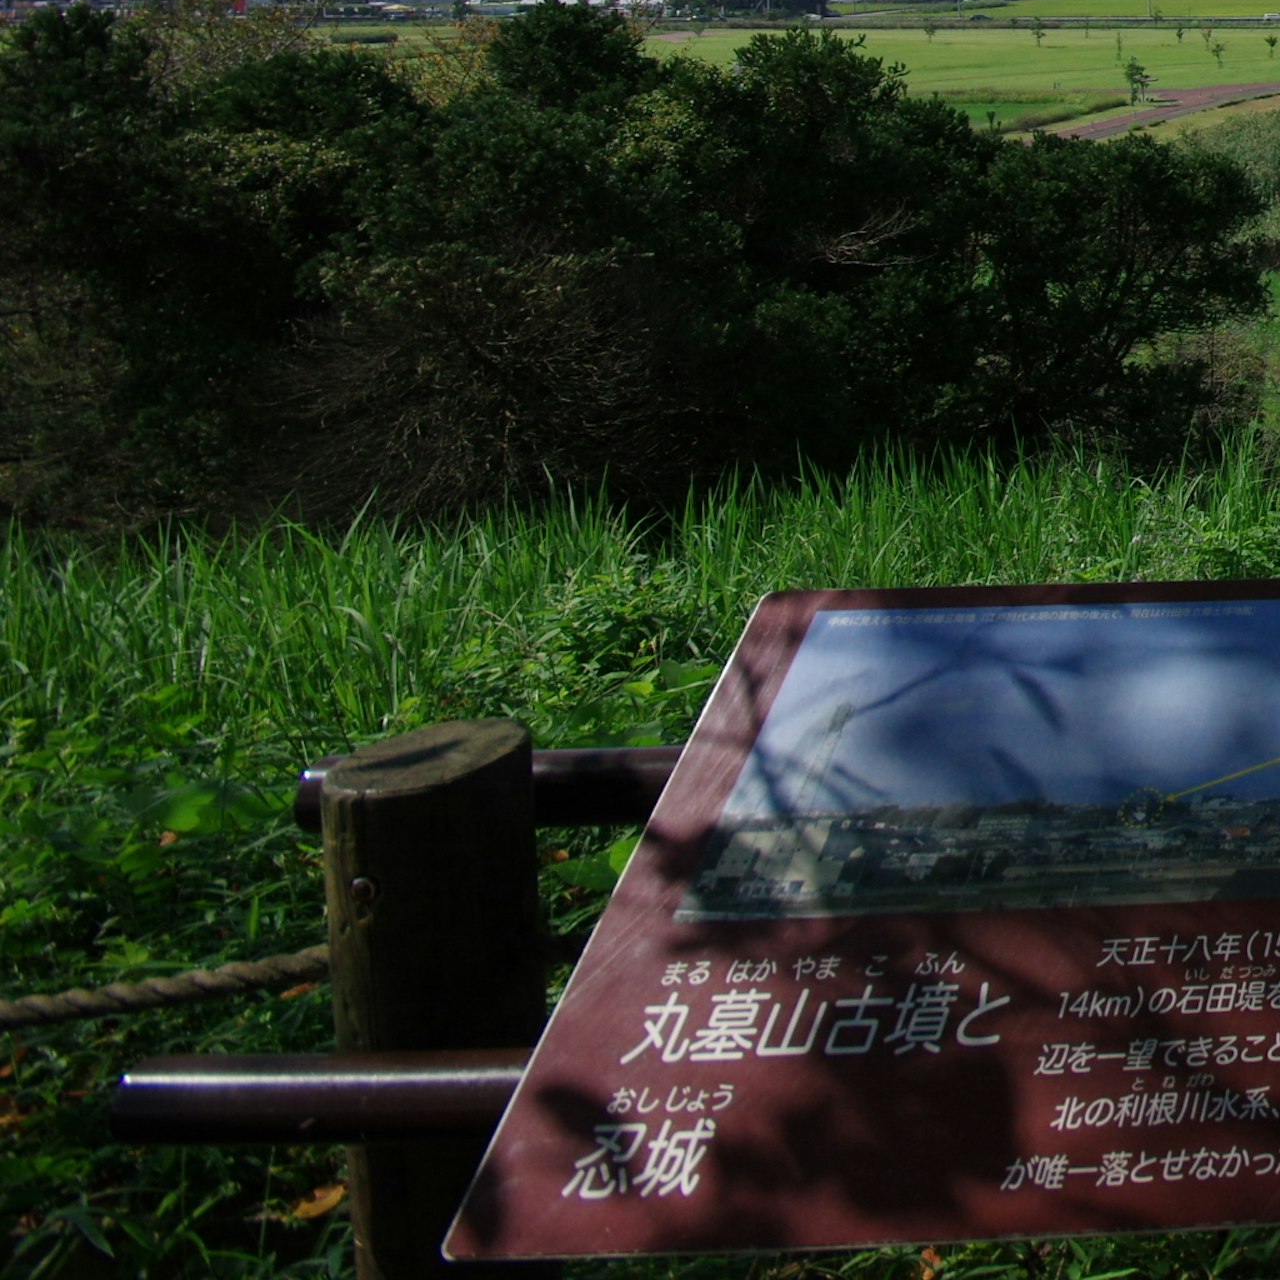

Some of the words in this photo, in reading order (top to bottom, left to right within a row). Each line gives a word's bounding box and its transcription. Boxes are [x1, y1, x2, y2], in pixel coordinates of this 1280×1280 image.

[660, 959, 711, 985] まる
[725, 957, 778, 983] はか
[792, 954, 842, 982] やま
[863, 954, 889, 977] こ
[914, 950, 967, 976] ふん
[619, 979, 1012, 1066] 丸墓山古墳と
[605, 1082, 735, 1115] おしじょう
[560, 1117, 717, 1200] 忍城
